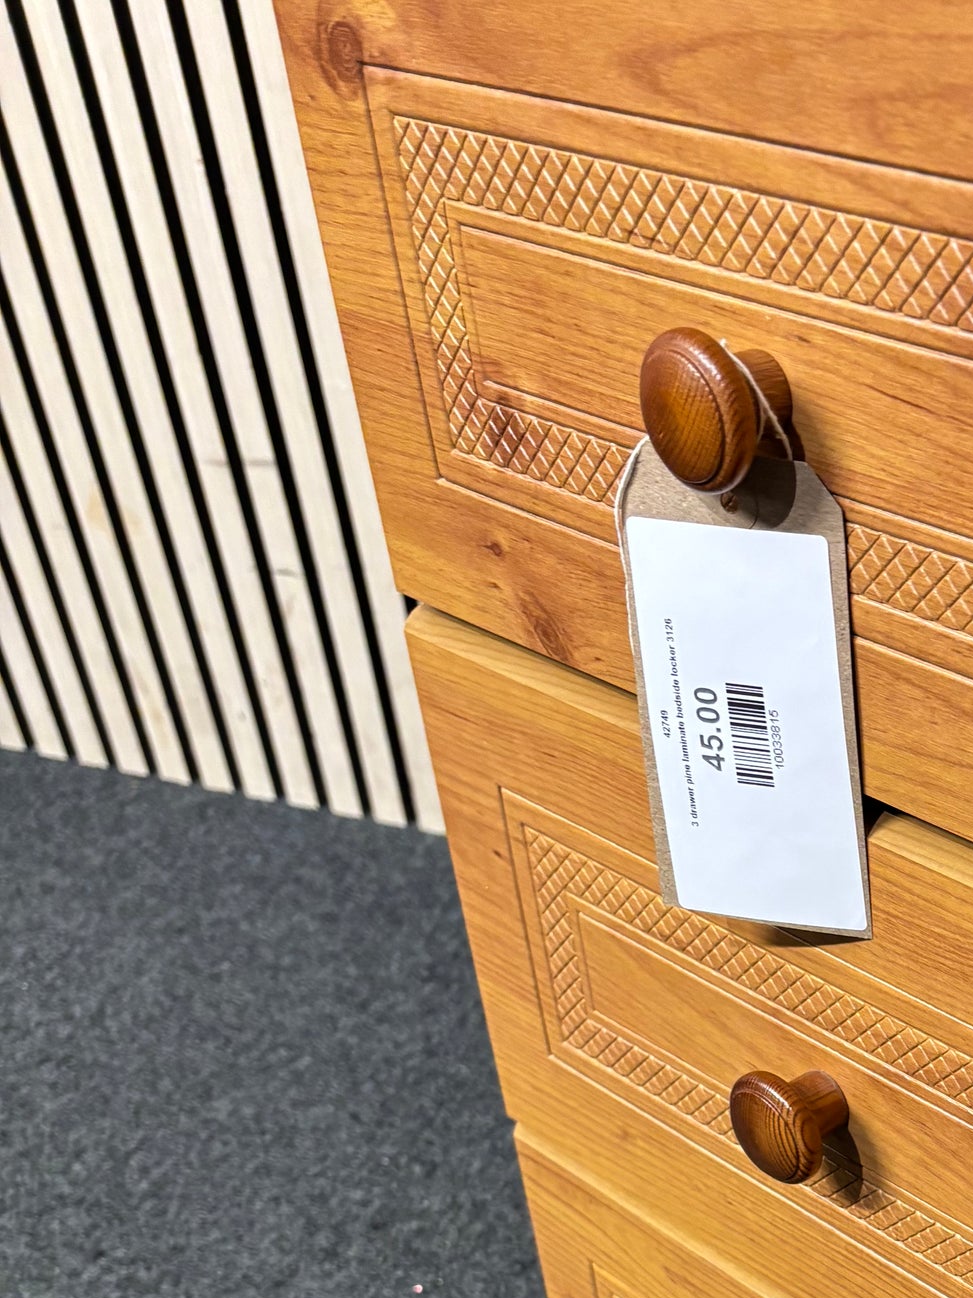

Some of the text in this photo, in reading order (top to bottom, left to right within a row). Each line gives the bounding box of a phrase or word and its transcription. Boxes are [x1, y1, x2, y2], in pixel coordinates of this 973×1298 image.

[663, 618, 674, 642] 3126
[668, 645, 679, 677] locker
[672, 679, 684, 719] bedside
[660, 709, 671, 739] 42749
[693, 687, 726, 772] 45.00
[769, 709, 785, 769] 10033815
[677, 721, 690, 763] laminate
[684, 764, 695, 785] pine
[687, 786, 698, 819] drawer
